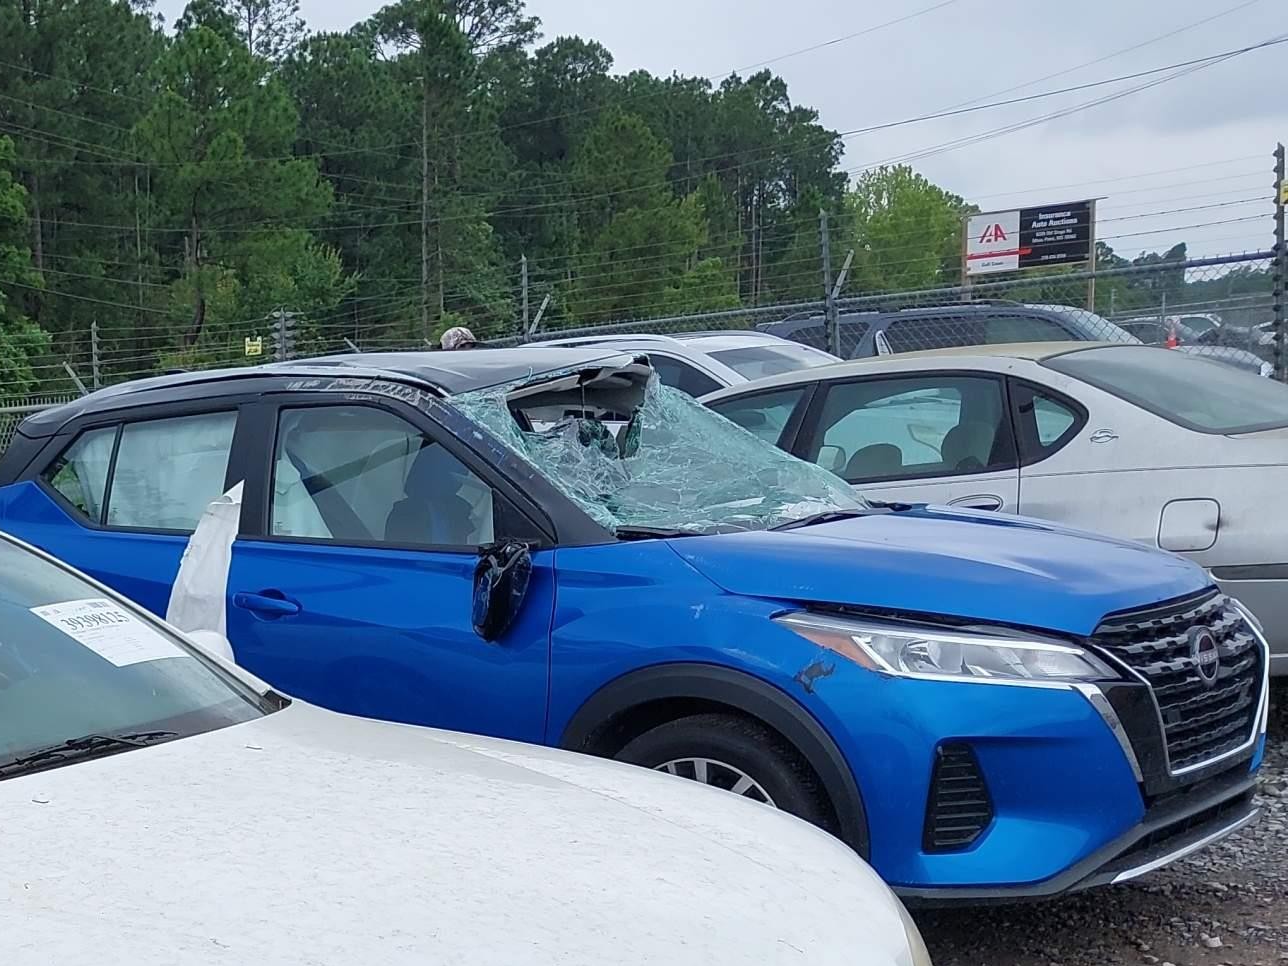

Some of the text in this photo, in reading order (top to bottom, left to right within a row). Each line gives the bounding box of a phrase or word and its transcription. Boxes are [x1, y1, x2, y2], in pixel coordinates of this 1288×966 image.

[1038, 211, 1072, 219] Insurance
[1031, 217, 1078, 229] Auto Auctions
[60, 610, 131, 632] 39398125
